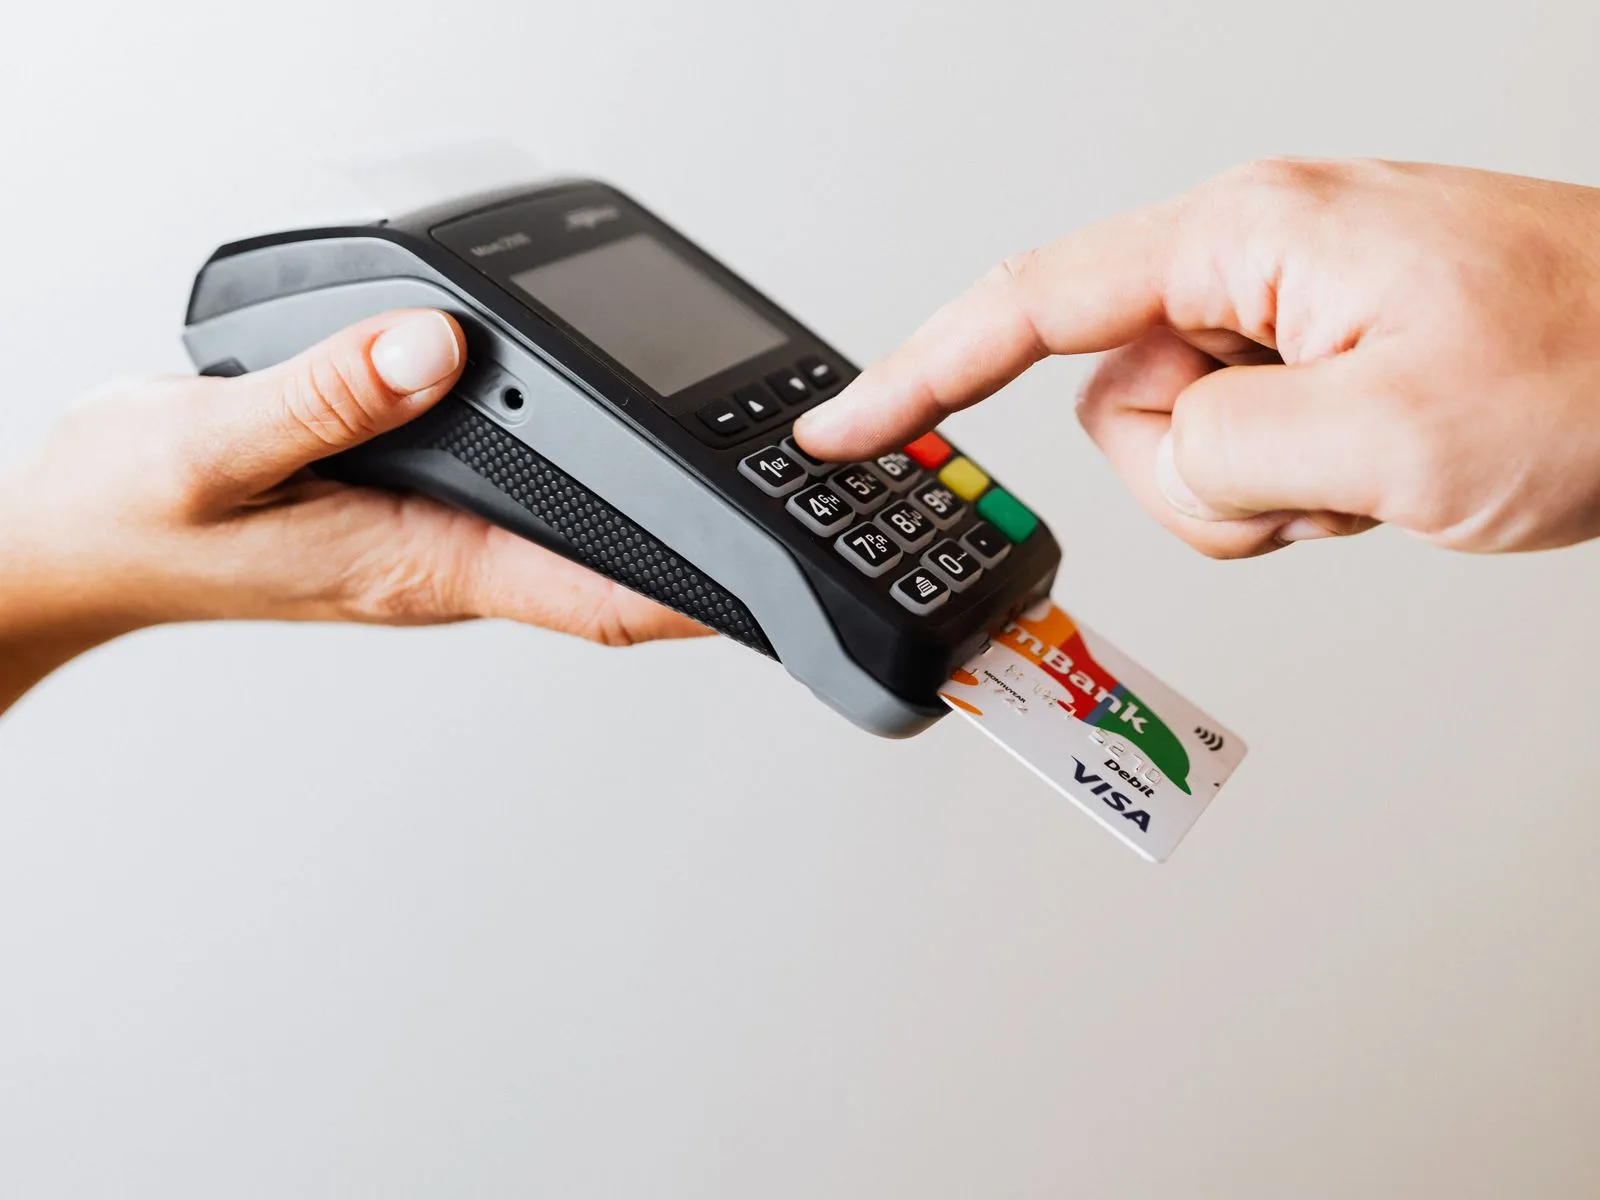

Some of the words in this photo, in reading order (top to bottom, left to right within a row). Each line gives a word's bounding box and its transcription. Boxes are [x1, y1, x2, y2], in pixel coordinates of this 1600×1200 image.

[1003, 622, 1149, 734] mBank
[1070, 754, 1151, 833] VISA
[1104, 759, 1155, 798] Debit
